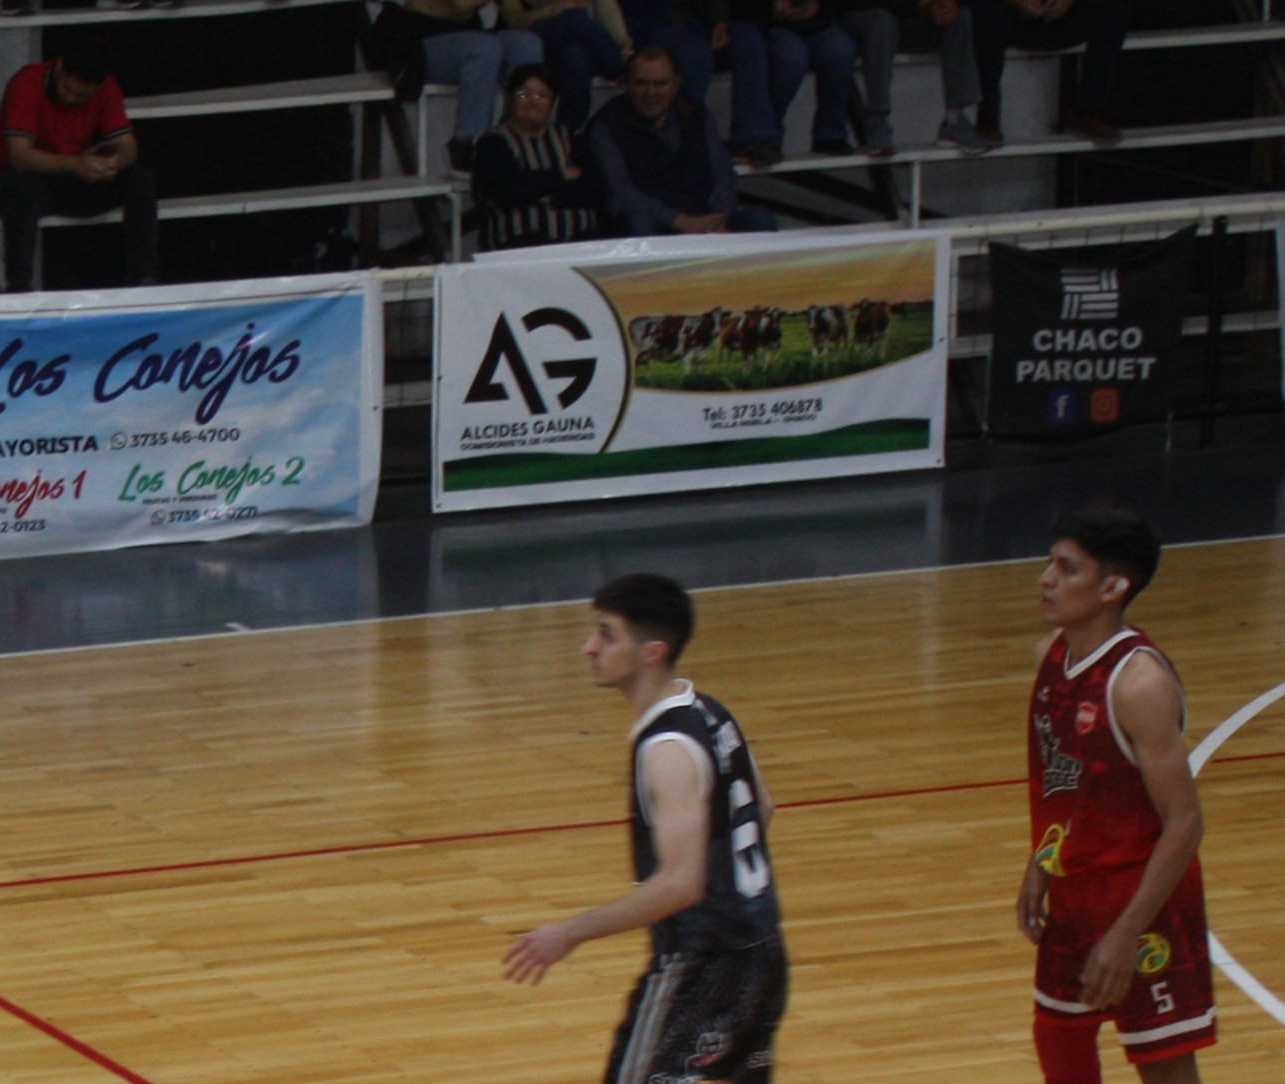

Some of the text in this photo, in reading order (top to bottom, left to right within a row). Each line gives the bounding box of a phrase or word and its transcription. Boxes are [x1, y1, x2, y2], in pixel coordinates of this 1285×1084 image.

[1032, 326, 1144, 352] CHACO
[93, 322, 302, 425] Conejos
[1016, 356, 1157, 383] PARQUET
[731, 402, 767, 419] 3735
[130, 431, 168, 448] 3735
[460, 416, 595, 441] ALCIDES GAUNA
[72, 469, 87, 499] 1
[117, 455, 306, 505] Los Conejos 2
[1150, 981, 1175, 1015] 5
